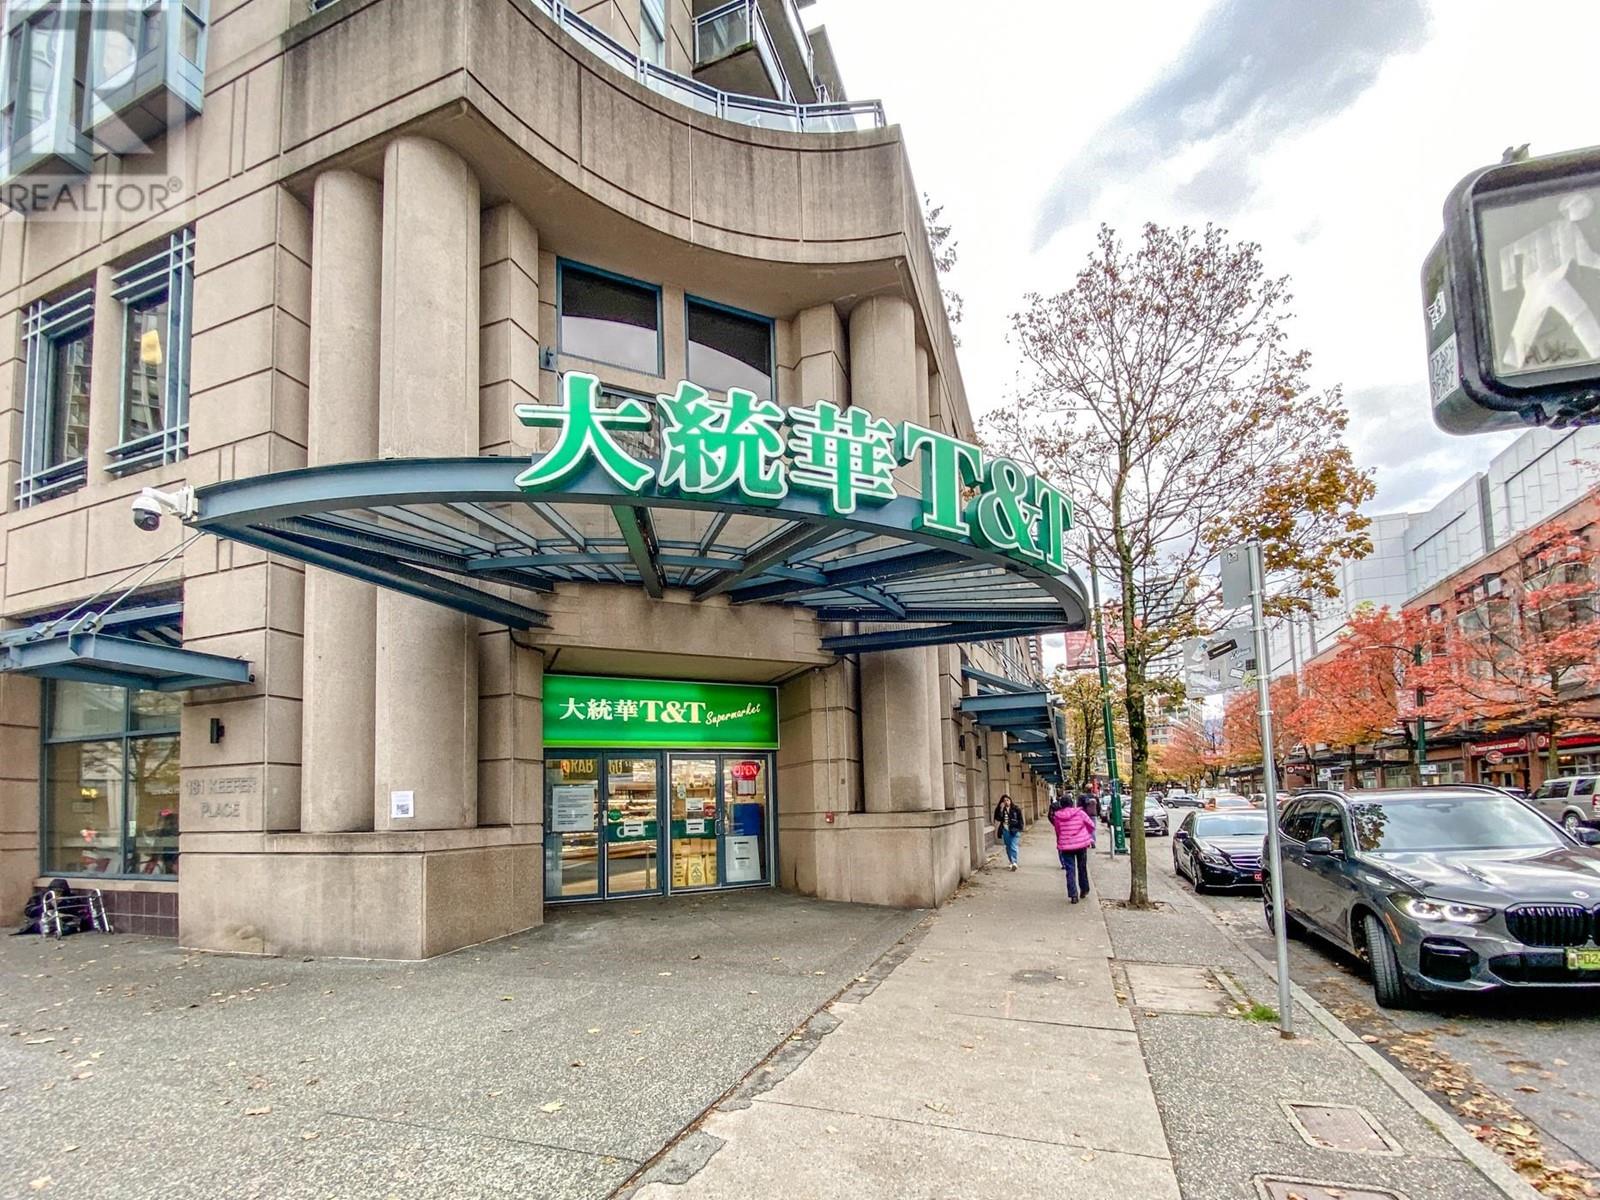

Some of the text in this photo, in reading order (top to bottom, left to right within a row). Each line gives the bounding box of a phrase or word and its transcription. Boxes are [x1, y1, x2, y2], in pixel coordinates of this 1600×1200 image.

[514, 371, 1074, 574] 大統華 T&T
[559, 697, 761, 728] 大統華 T&T Supermarket
[733, 764, 758, 777] OPEN
[200, 800, 241, 819] PLACE
